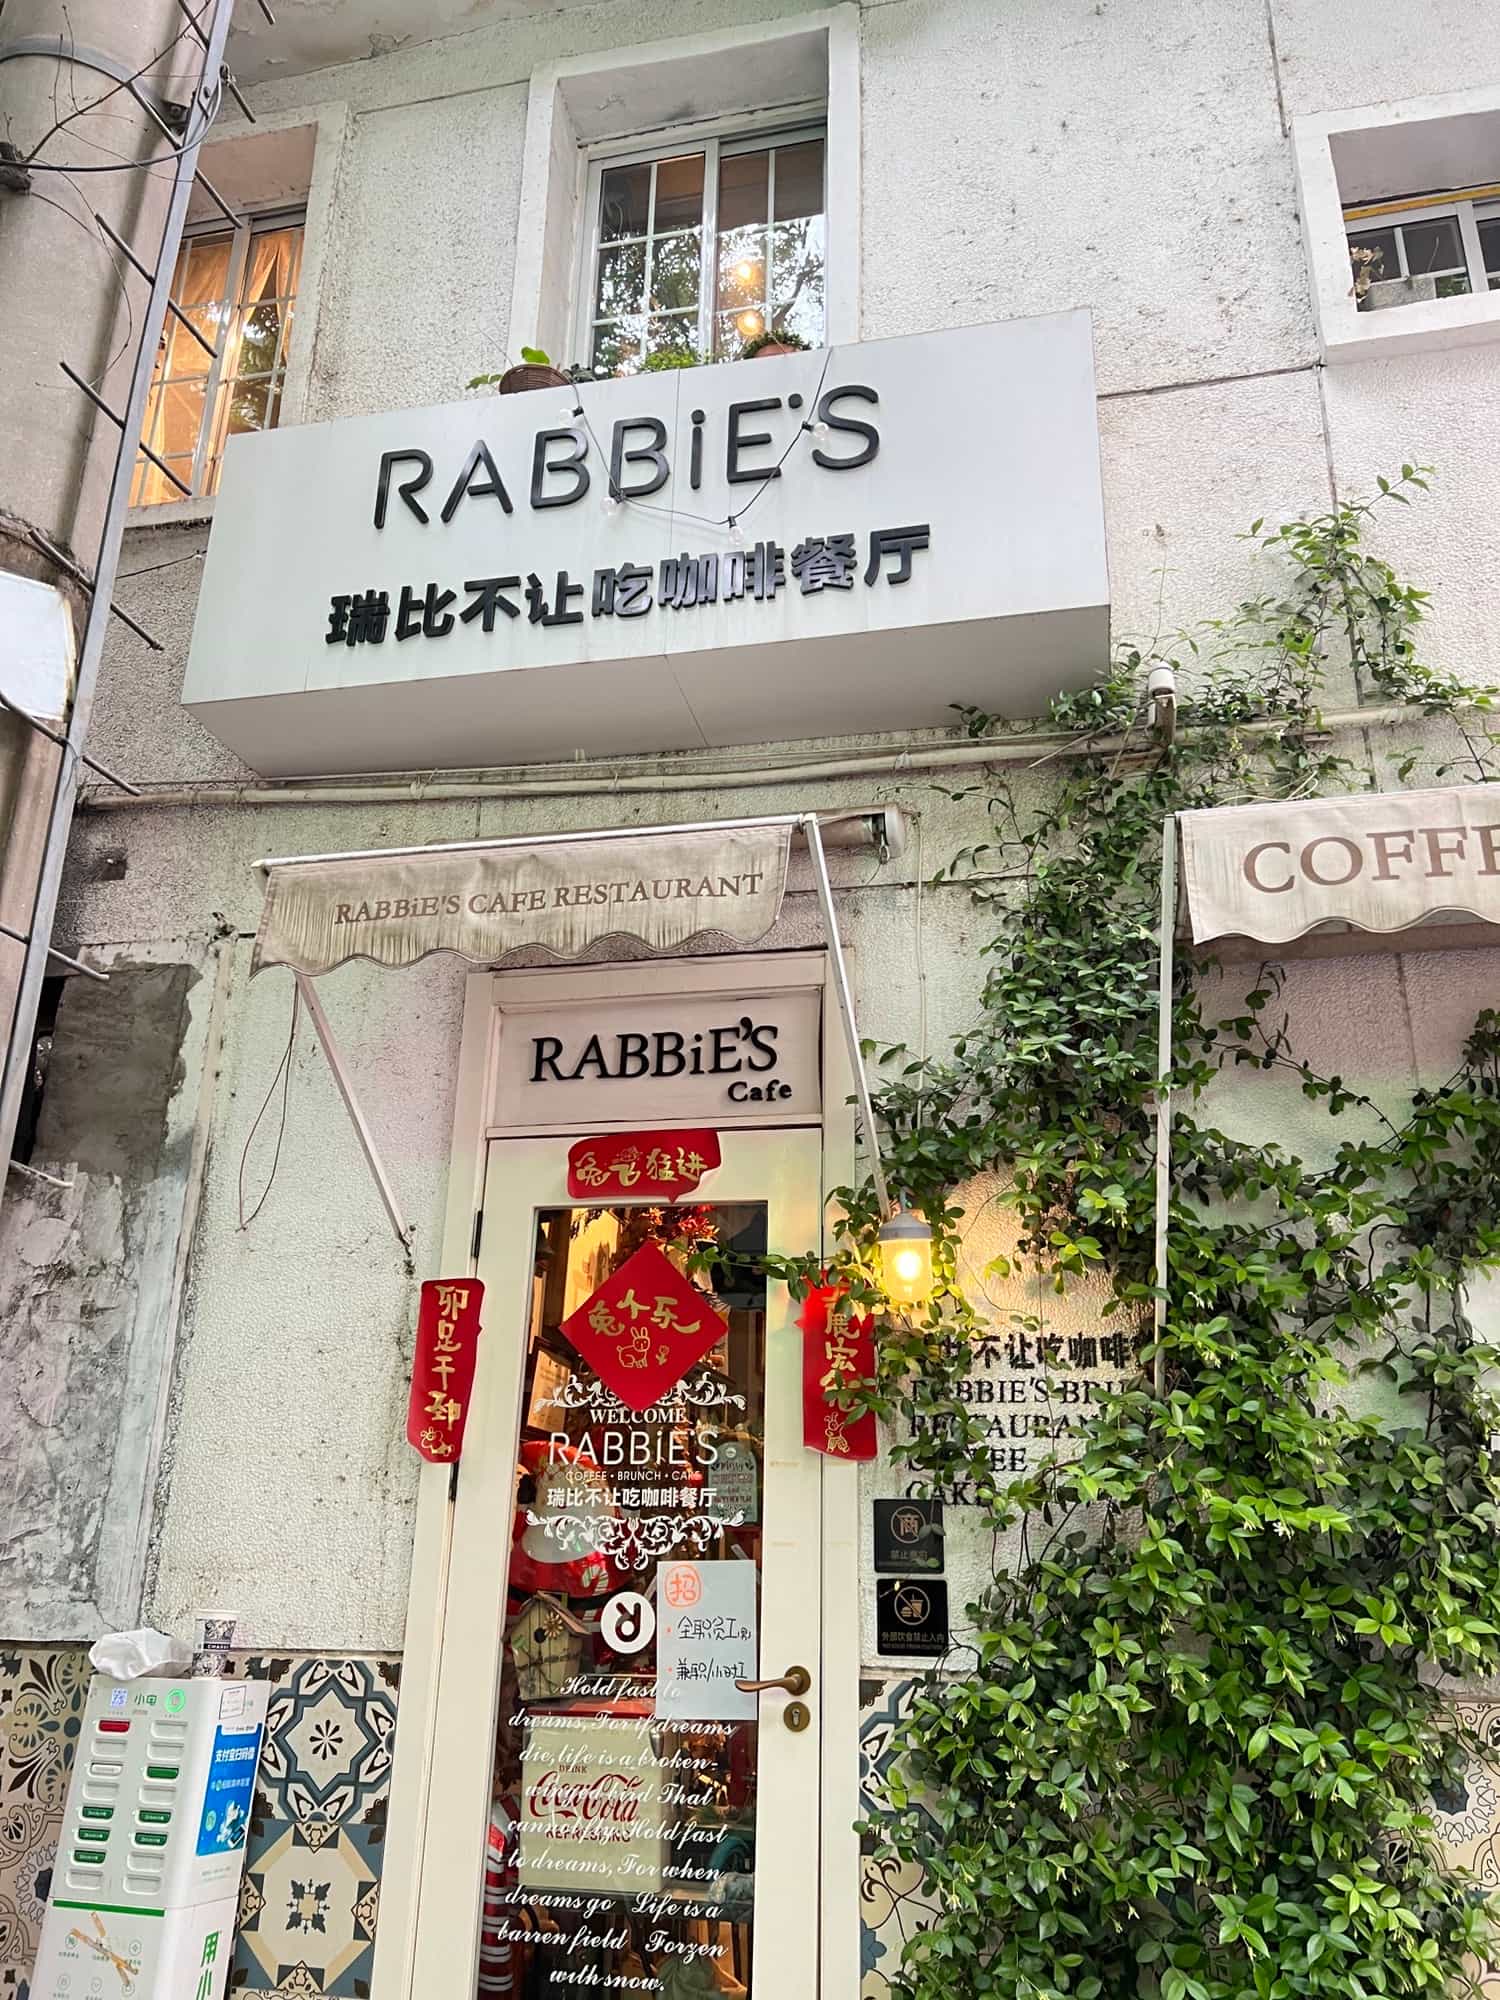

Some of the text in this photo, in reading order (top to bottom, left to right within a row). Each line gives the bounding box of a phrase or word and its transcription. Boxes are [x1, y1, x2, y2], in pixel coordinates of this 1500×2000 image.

[325, 524, 931, 647] 瑞比不让吃咖啡餐厅
[334, 872, 764, 925] RABBiE'S CAFE RESTAURANT
[529, 1016, 780, 1083] RABBiE'S
[727, 1079, 793, 1104] Cafe
[424, 1285, 470, 1431] 卯足干劲
[910, 1376, 1049, 1404] BBIE'S
[590, 1407, 687, 1424] WELCOME
[565, 1470, 608, 1481] COFFEE
[617, 1470, 662, 1481] BRUNCH
[547, 1486, 717, 1509] 瑞比不让吃咖啡餐厅
[670, 1573, 697, 1602] 招
[560, 1674, 617, 1697] Hold
[610, 1678, 661, 1705] fast
[508, 1707, 739, 1740] dreams, For if dreams
[519, 1742, 719, 1772] die, life is a broken-
[606, 1780, 654, 1803] bird
[657, 1781, 714, 1808] That
[623, 1817, 680, 1842] Hold
[676, 1821, 729, 1850] fast
[507, 1847, 724, 1882] to dreams, For when
[504, 1884, 723, 1923] dreams go Life is a
[497, 1921, 729, 1965] barren field Forzen
[549, 1964, 665, 1992] with snow.
